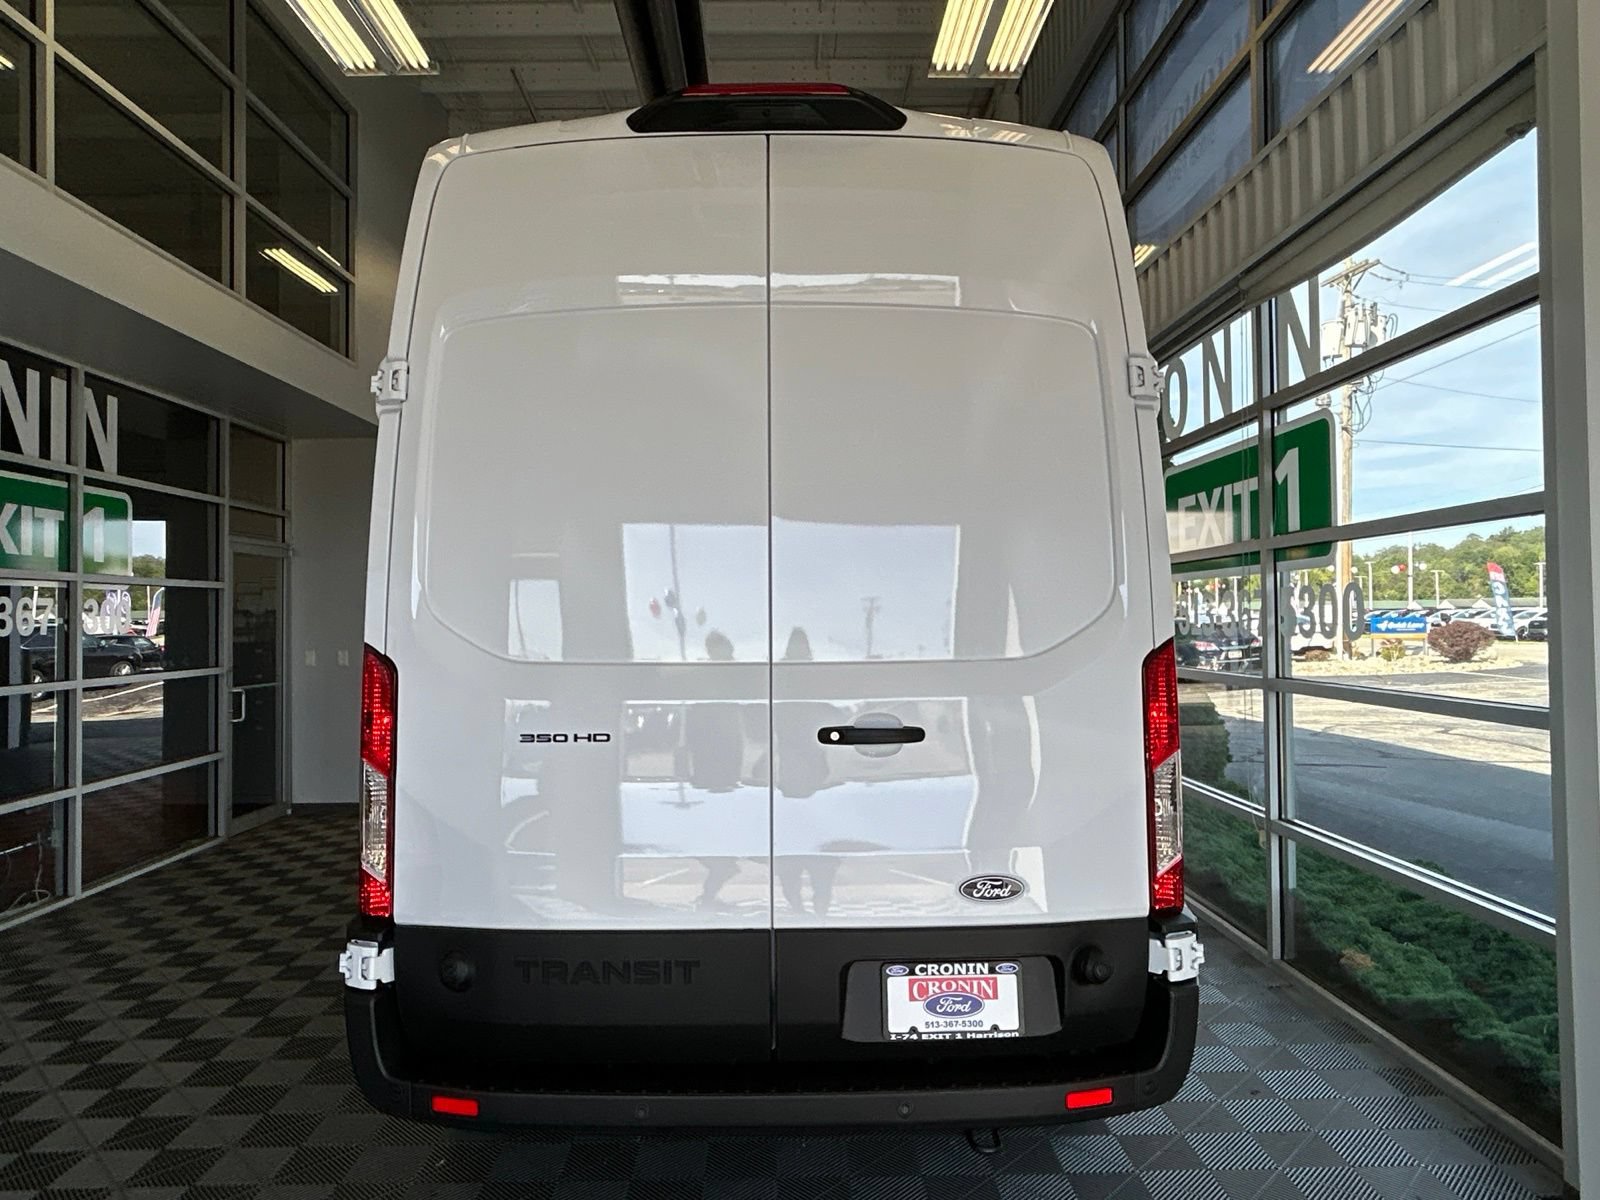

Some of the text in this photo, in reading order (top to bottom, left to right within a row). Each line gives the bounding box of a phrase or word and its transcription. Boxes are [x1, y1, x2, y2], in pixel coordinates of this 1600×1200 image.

[1178, 447, 1300, 553] EXIT 1
[519, 733, 611, 743] 350 HD
[972, 878, 1012, 898] Ford
[513, 959, 700, 985] TRANSIT
[914, 962, 989, 976] CRONIN
[912, 979, 994, 1001] CRONIN
[935, 996, 972, 1012] Ford
[925, 1020, 984, 1029] 513-367-5300
[890, 1033, 919, 1041] I-74
[966, 1031, 1020, 1039] Harrison
